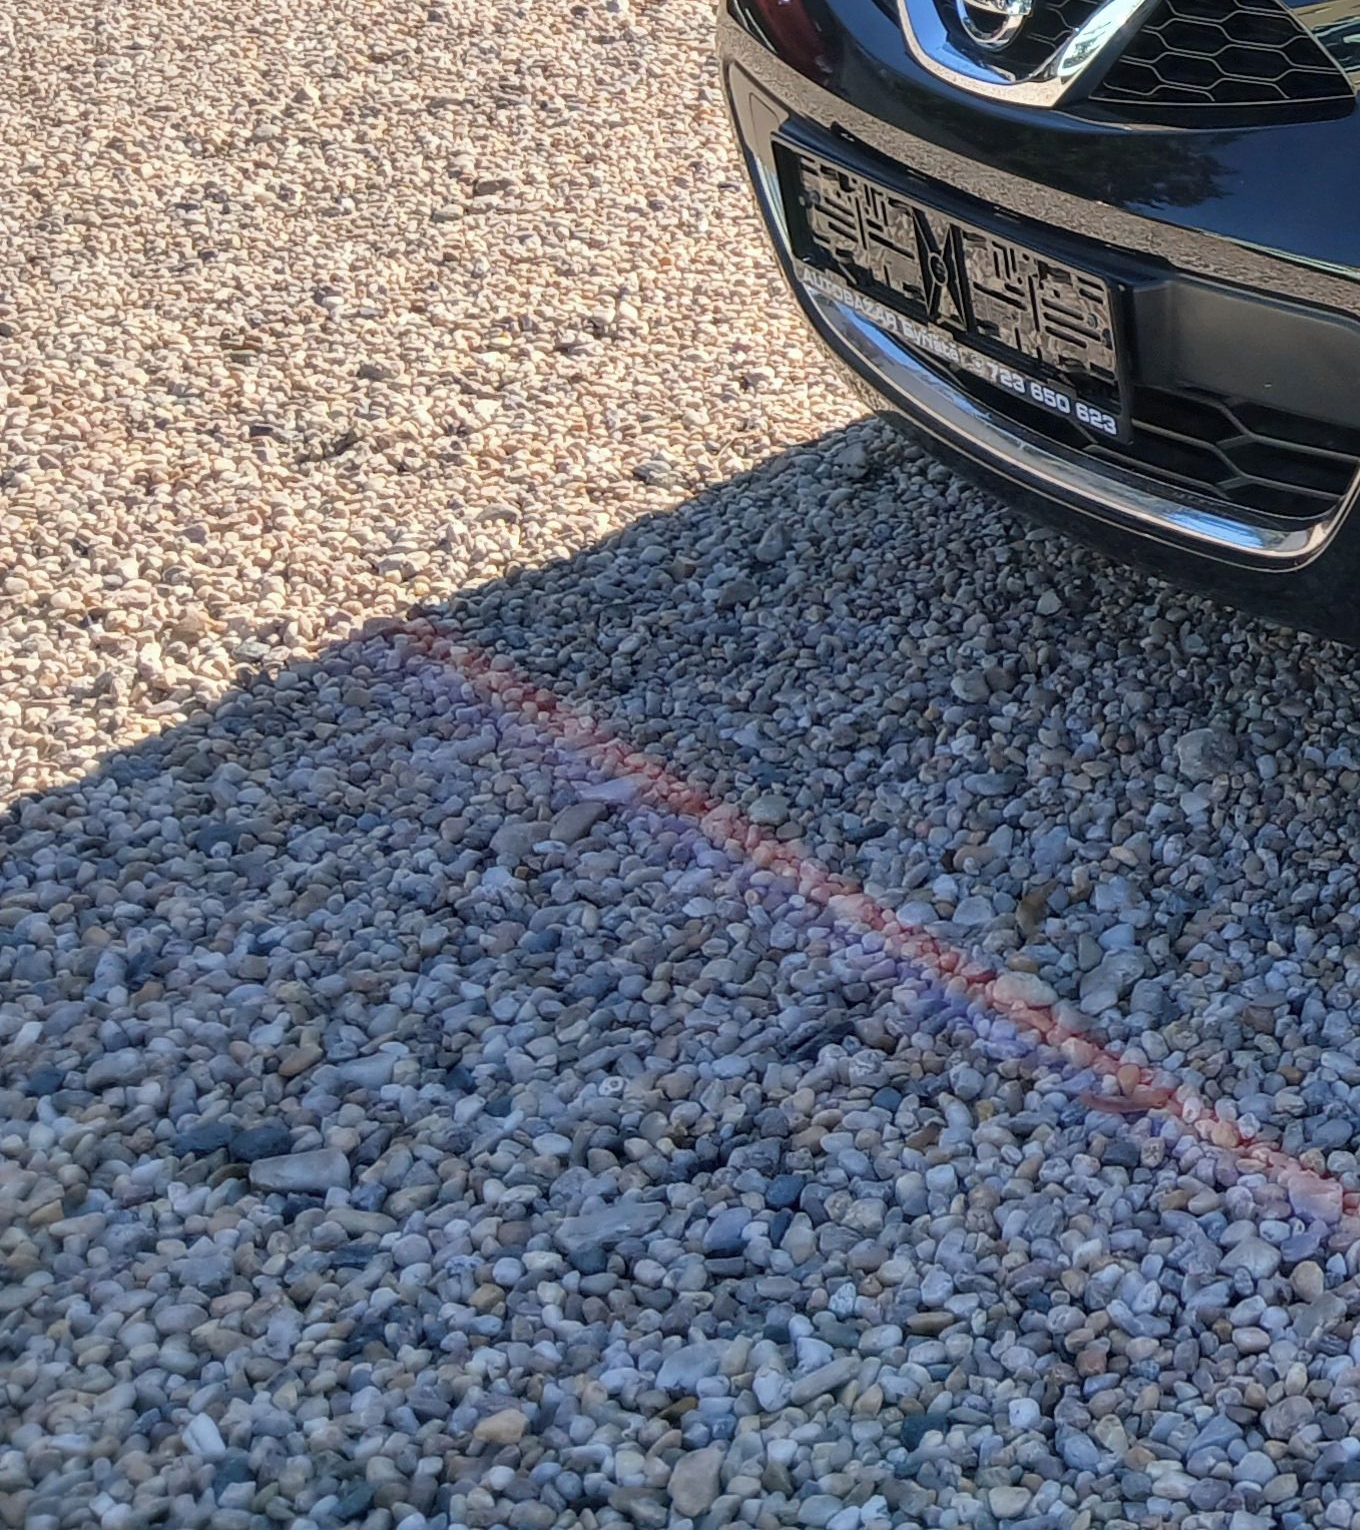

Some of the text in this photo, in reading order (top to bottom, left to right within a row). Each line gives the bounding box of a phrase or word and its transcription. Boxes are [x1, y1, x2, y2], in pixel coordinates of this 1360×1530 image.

[802, 268, 898, 331] AUTOBAZAR
[985, 361, 1026, 394] 723
[1030, 382, 1071, 414] 650
[1075, 402, 1117, 435] 623
